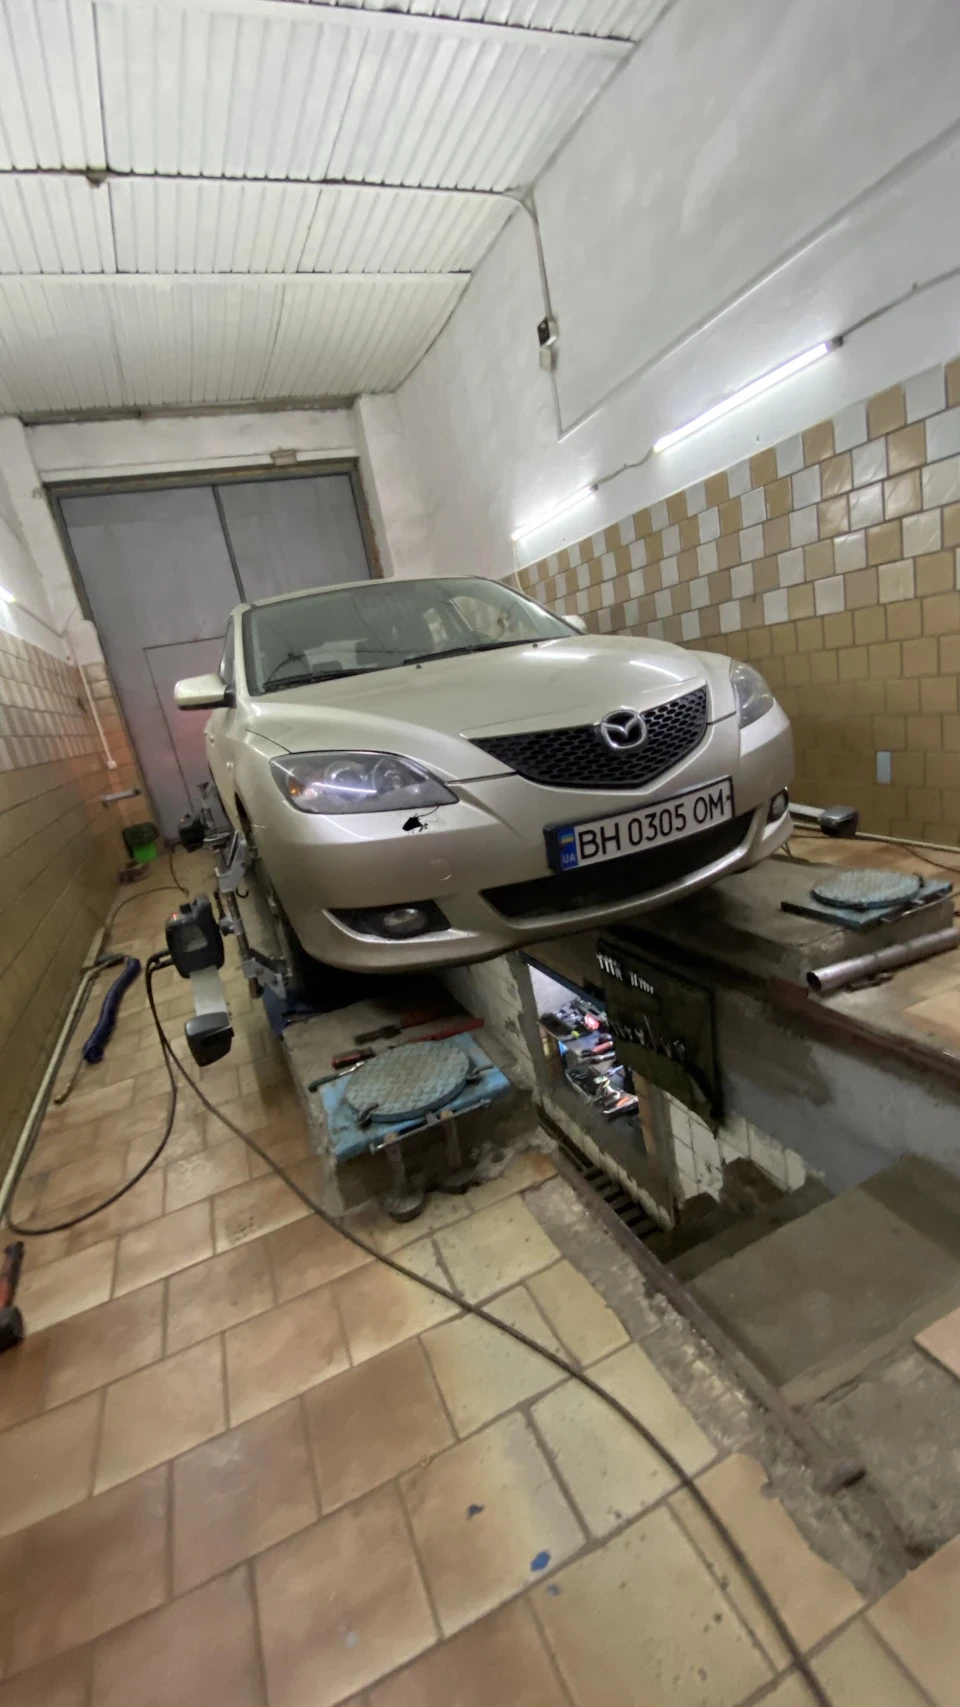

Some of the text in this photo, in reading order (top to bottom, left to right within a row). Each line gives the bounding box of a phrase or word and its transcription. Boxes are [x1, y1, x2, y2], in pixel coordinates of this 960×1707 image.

[578, 789, 725, 860] BH 0305 OM
[562, 853, 577, 865] UA
